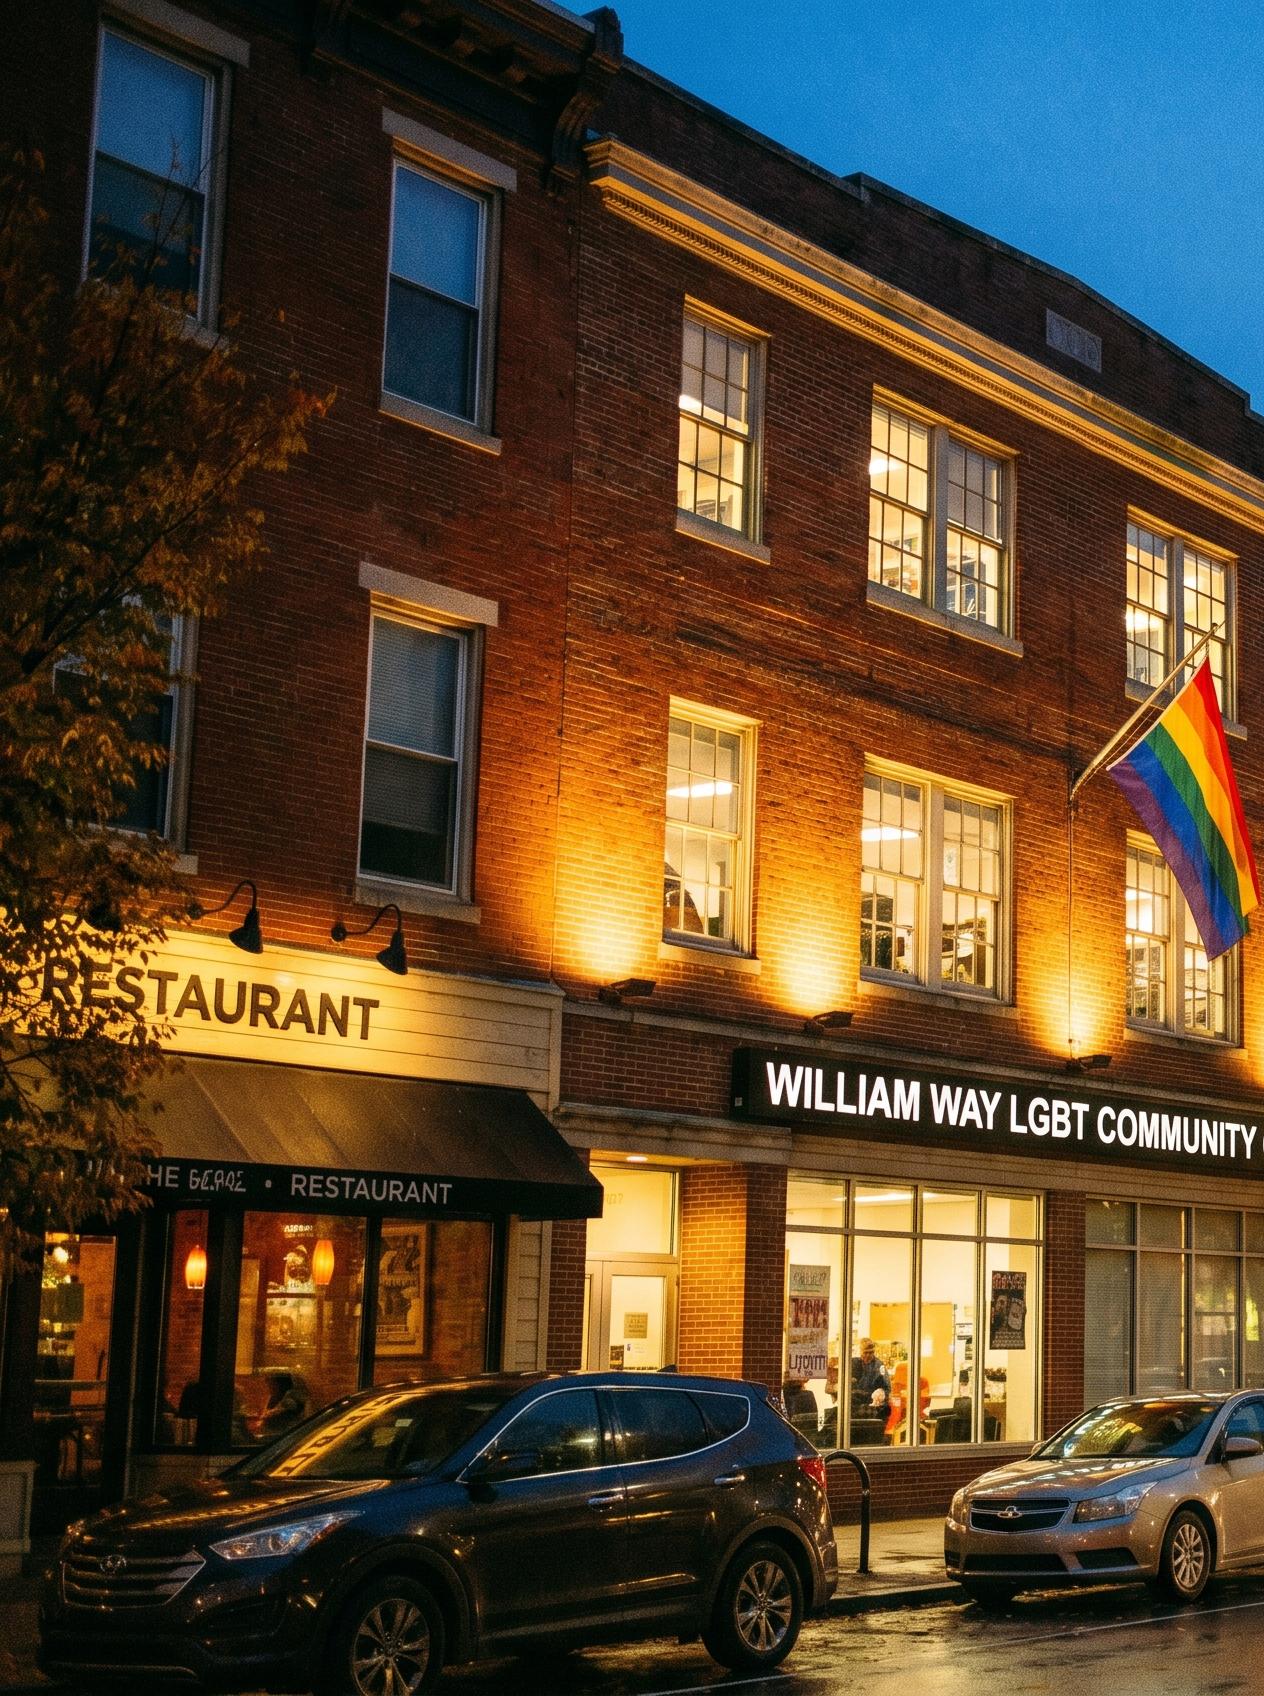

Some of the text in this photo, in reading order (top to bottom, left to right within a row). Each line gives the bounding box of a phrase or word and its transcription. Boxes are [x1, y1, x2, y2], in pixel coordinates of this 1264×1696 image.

[43, 955, 380, 1040] RESTAURANT
[766, 1062, 920, 1121] WILLIAM
[930, 1083, 1001, 1130] WAY
[1010, 1094, 1089, 1140] LGBT
[1097, 1106, 1257, 1159] COMMUNITY
[290, 1174, 453, 1204] RESTAURANT
